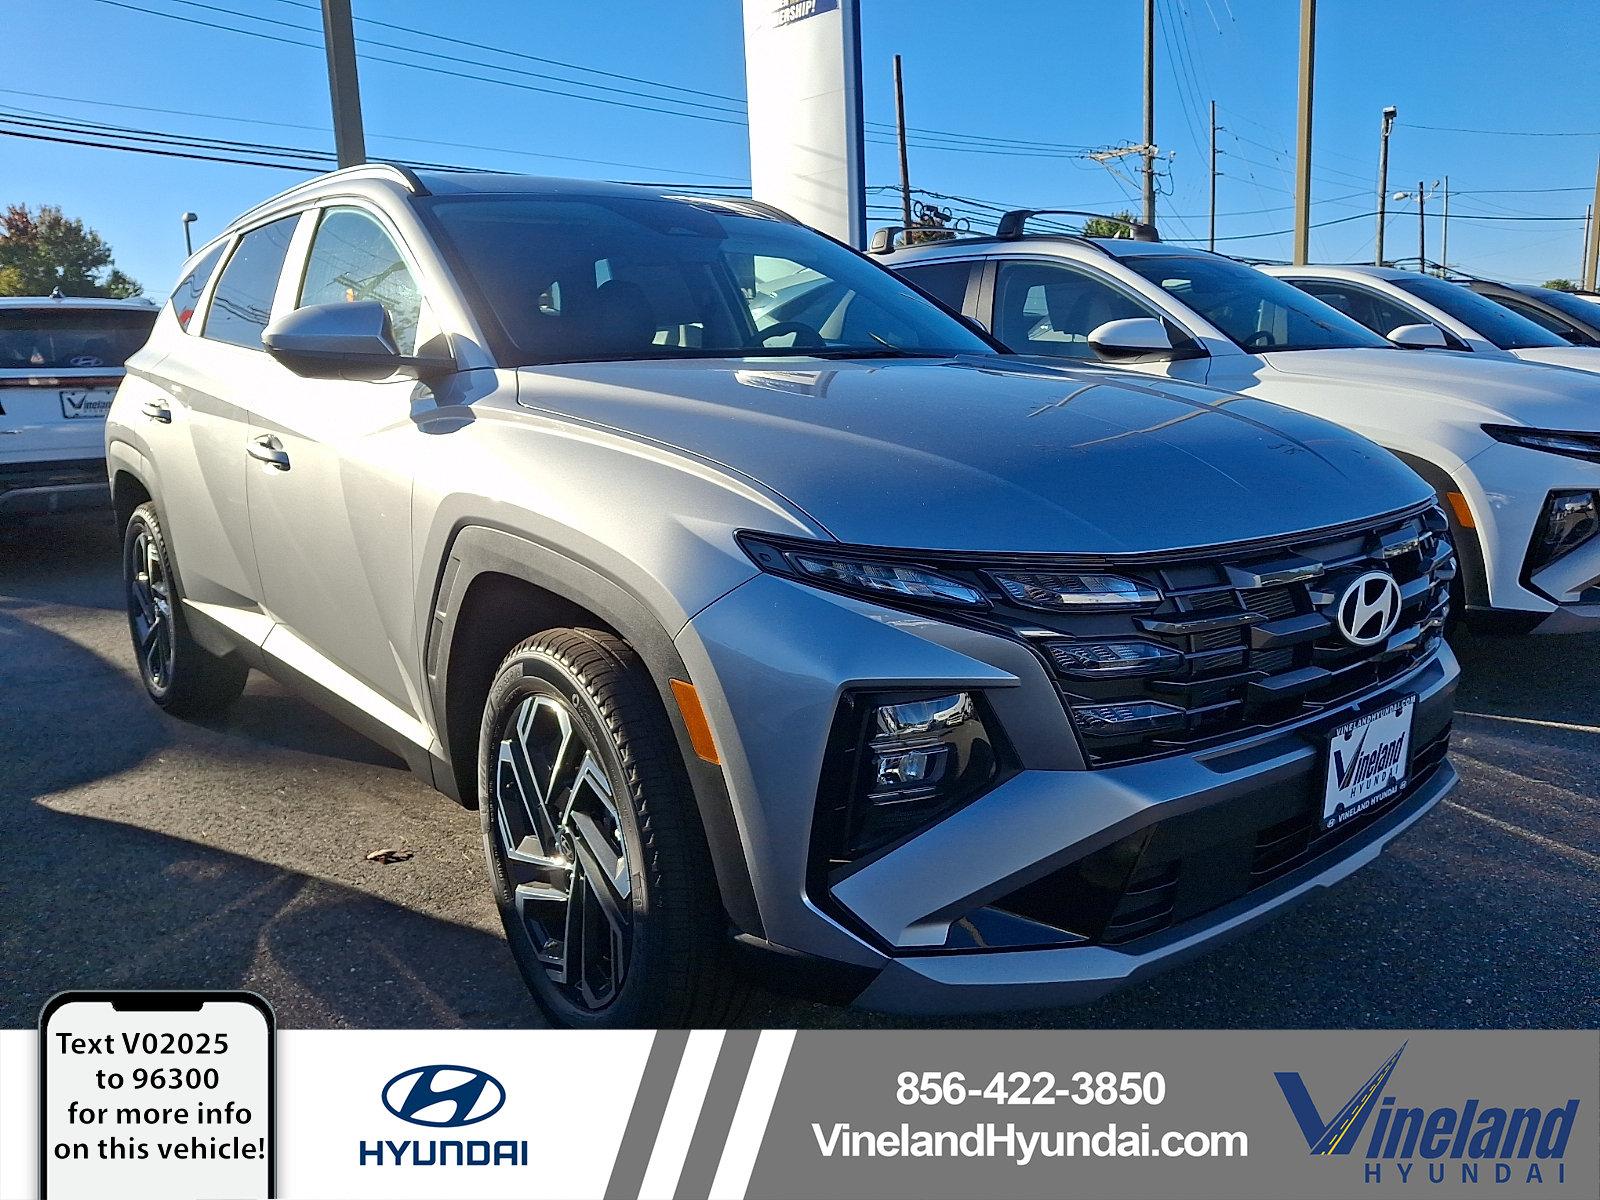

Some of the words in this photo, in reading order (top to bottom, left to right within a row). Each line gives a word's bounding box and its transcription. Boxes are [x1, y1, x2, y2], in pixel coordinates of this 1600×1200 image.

[1333, 721, 1406, 791] Vineland
[1350, 763, 1399, 799] HYUNDAI
[1338, 800, 1370, 823] VINELAND
[1370, 784, 1398, 807] HYUNDAI
